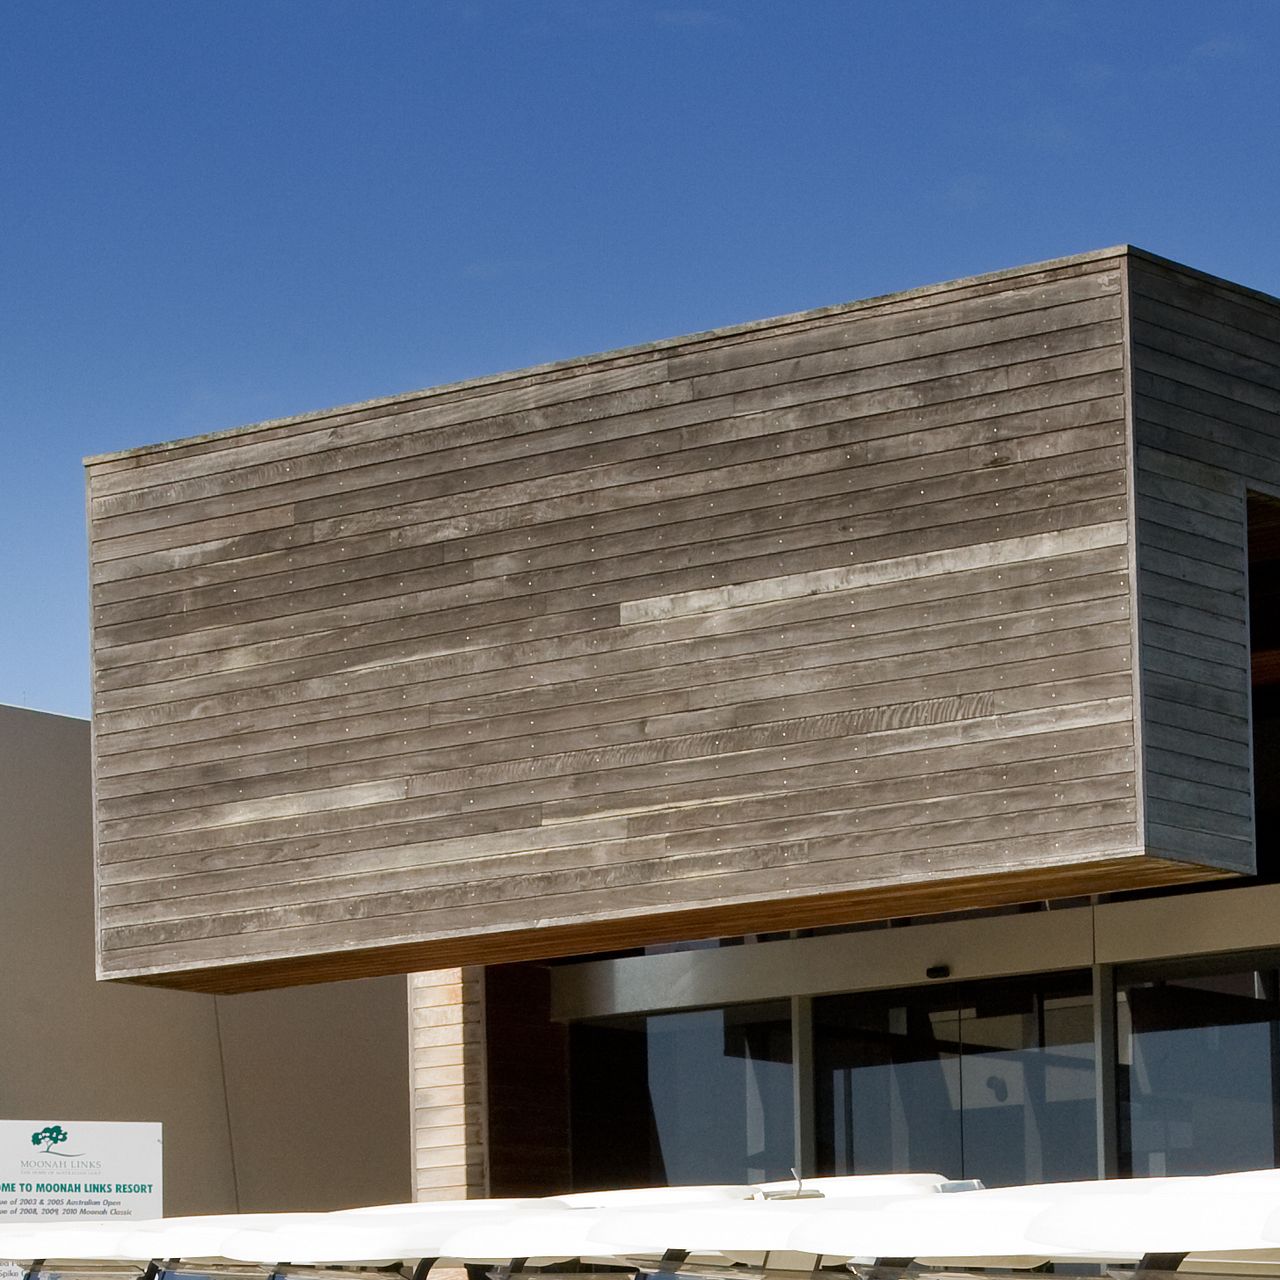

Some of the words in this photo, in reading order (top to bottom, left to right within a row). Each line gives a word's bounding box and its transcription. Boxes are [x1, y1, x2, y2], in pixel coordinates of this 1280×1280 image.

[20, 1160, 67, 1169] MOONAH
[71, 1160, 102, 1169] LINKS
[19, 1183, 33, 1193] TO
[36, 1183, 81, 1193] MOONAH
[84, 1183, 113, 1193] LINKS
[115, 1183, 153, 1194] RESORT
